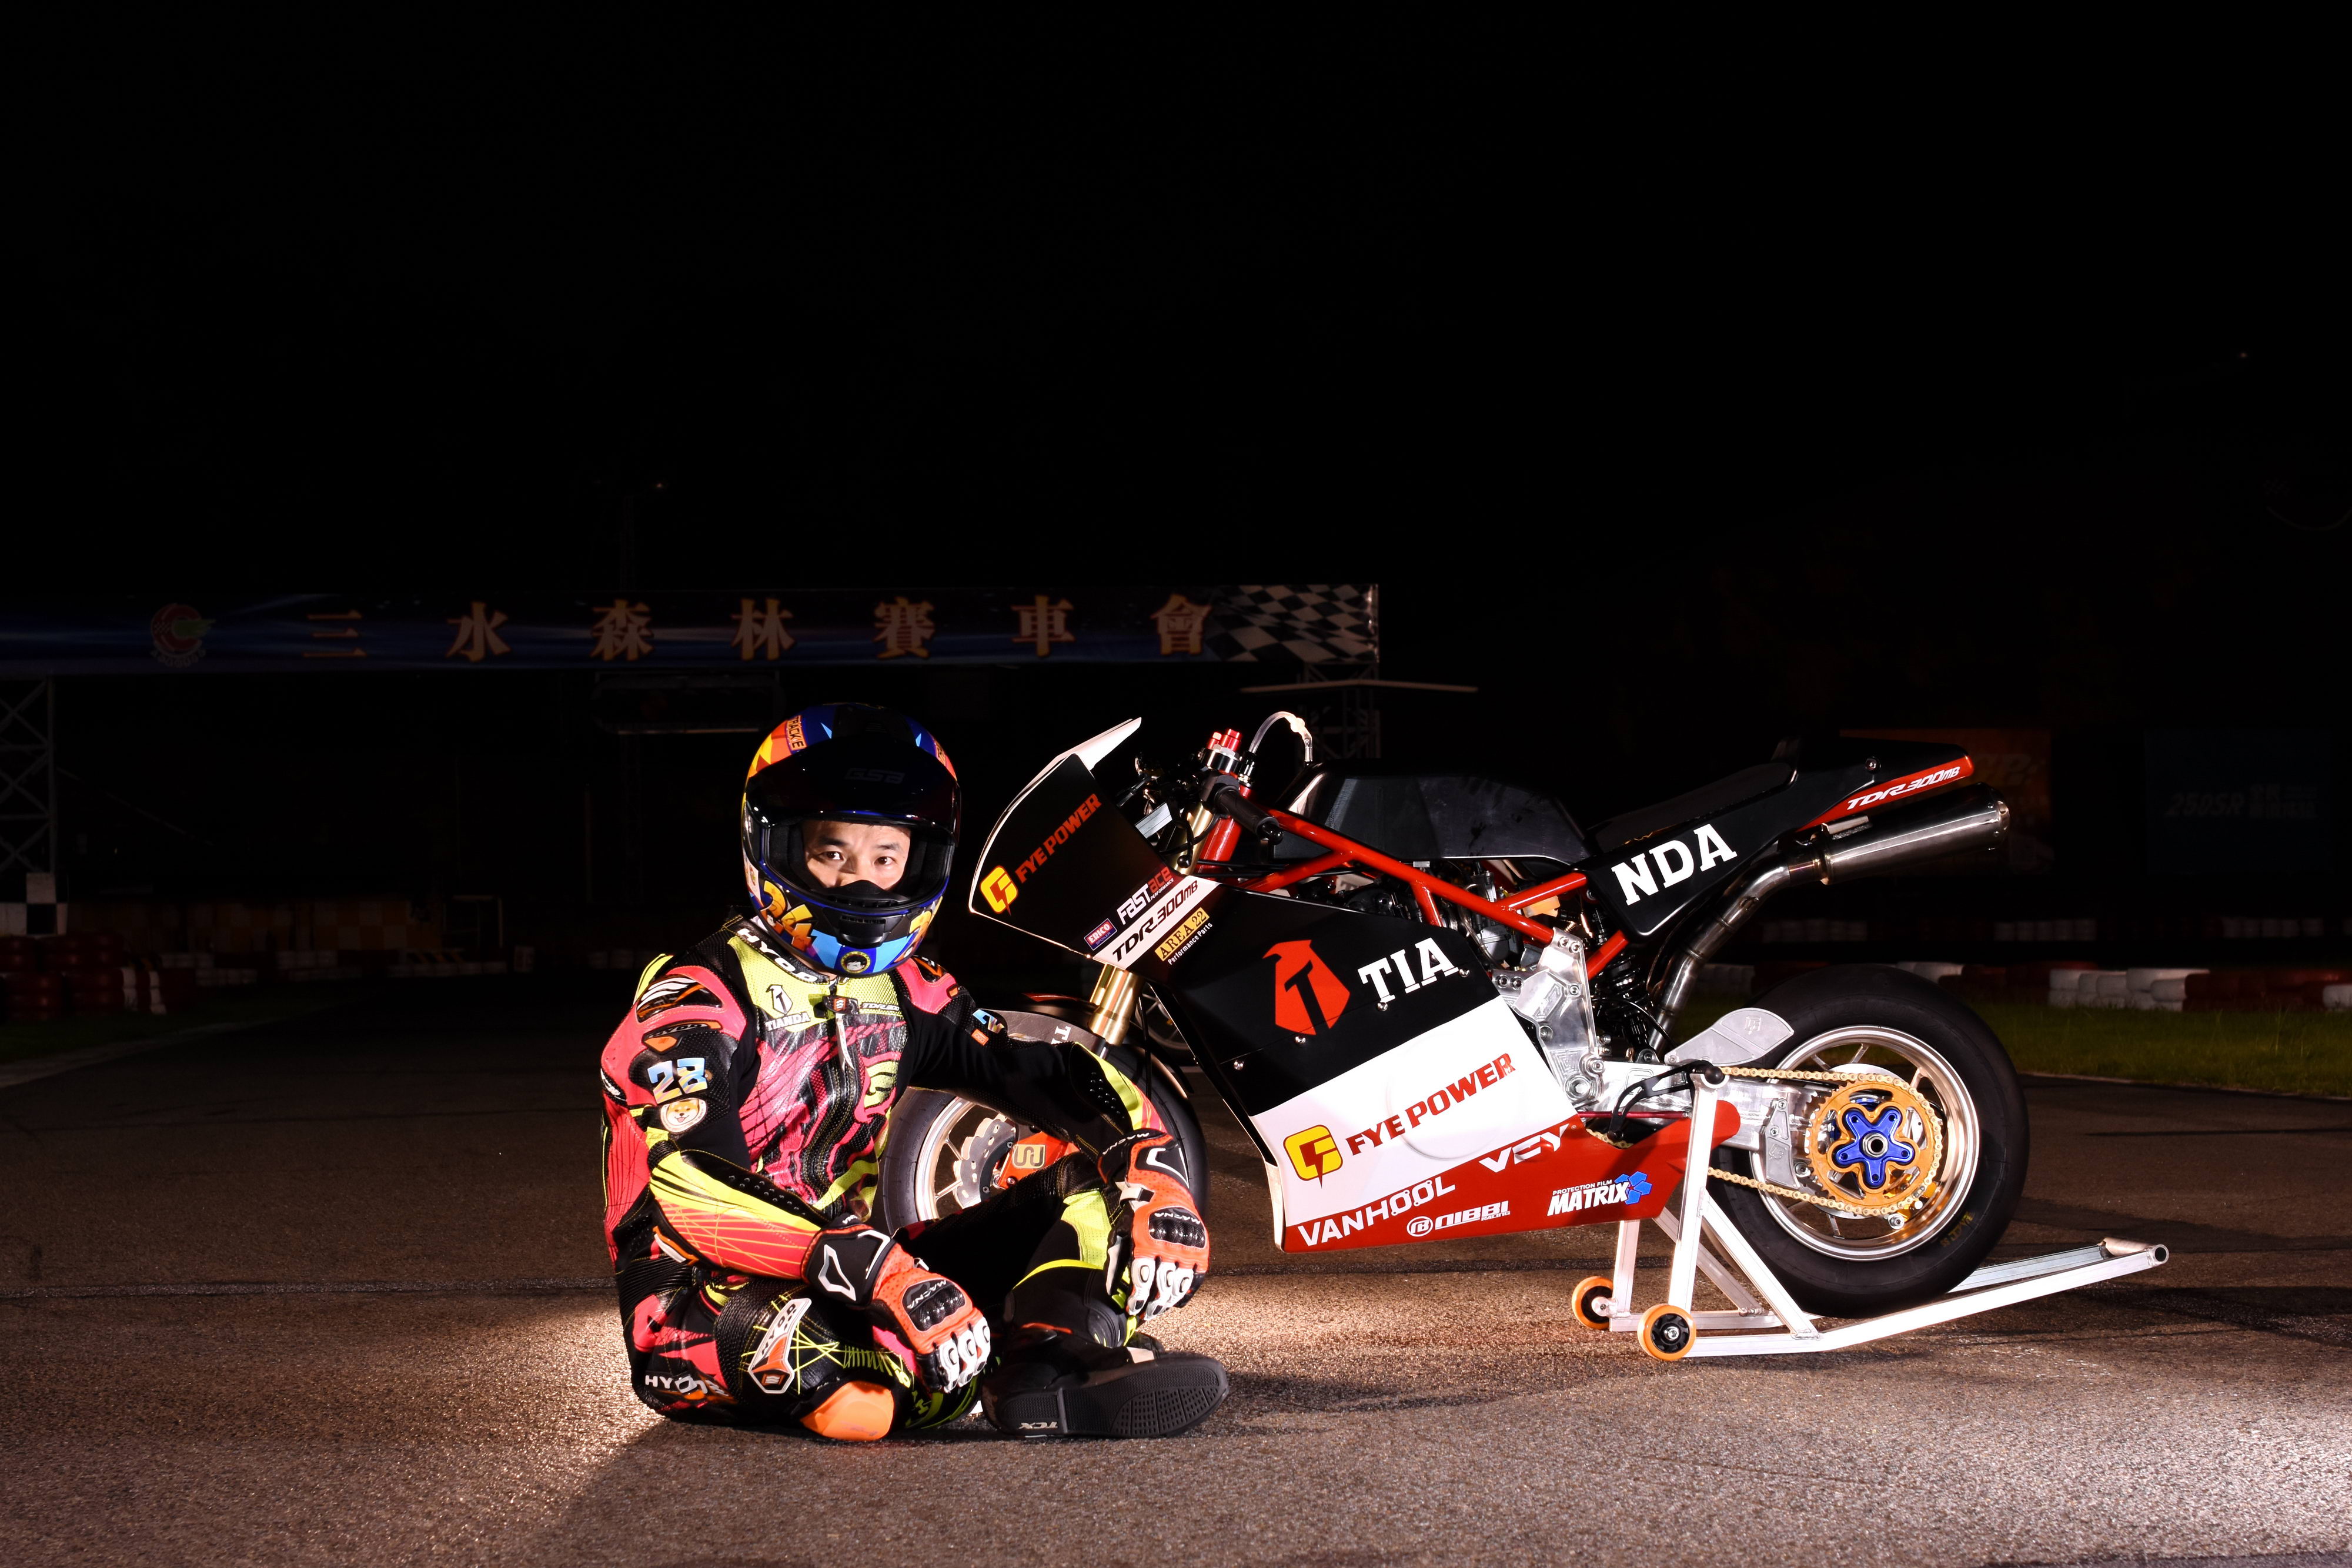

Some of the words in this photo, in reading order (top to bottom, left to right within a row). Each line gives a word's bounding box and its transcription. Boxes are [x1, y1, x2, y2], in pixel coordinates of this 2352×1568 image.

[302, 593, 1212, 662] 三水森林賽車會
[1015, 847, 1048, 884] FYE
[1043, 794, 1102, 855] POWER
[1611, 824, 1738, 906] NDA
[1150, 878, 1174, 901] PERFORMANCE
[1088, 923, 1111, 942] ERICO
[1160, 924, 1194, 959] AREA
[1192, 911, 1207, 927] 22
[1167, 934, 1200, 965] Performance
[1198, 922, 1213, 938] Parts
[1358, 938, 1459, 1002] TIA
[765, 1011, 810, 1031] TIANDA
[647, 1058, 707, 1104] 28
[1345, 1115, 1405, 1156] FYE
[1405, 1054, 1516, 1128] POWER
[1298, 1176, 1455, 1246] VANHOOL
[1547, 1182, 1630, 1216] MATRIX
[1552, 1182, 1595, 1196] PROTECTION
[1154, 1212, 1201, 1225] MACNA
[907, 1280, 947, 1309] MACNA
